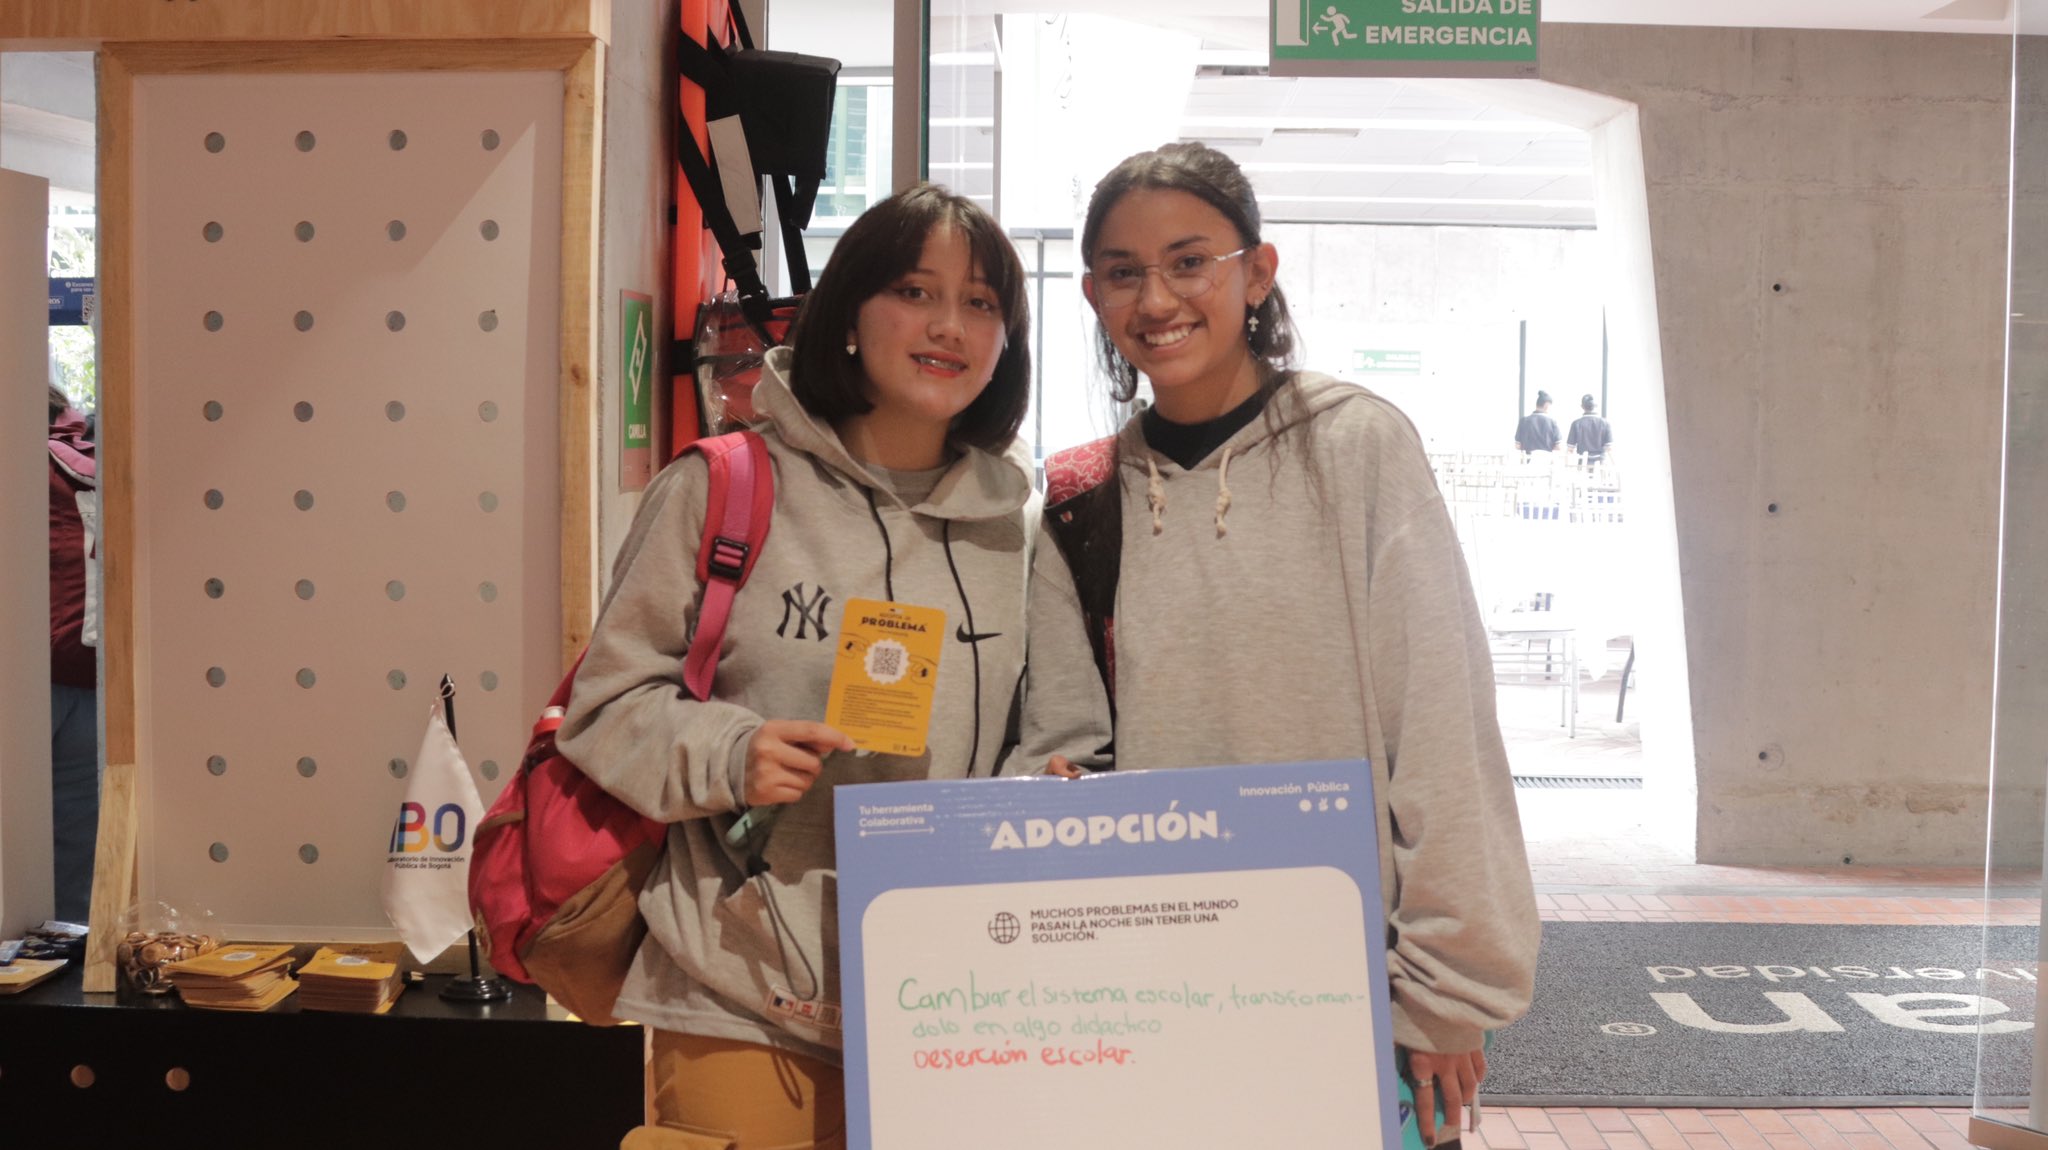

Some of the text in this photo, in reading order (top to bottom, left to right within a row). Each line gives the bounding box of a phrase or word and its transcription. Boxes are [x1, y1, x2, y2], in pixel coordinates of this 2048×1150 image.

[1401, 0, 1532, 14] SALIDA DE
[1365, 25, 1532, 46] EMERGENCIA
[861, 616, 927, 632] PROBLEMA
[1240, 781, 1350, 797] Innovación Pública
[859, 803, 934, 815] Tu herramienta
[859, 815, 925, 827] Colaborativa
[990, 800, 1218, 850] ADOPCIÓN
[428, 862, 451, 870] Bogotá
[429, 855, 465, 863] Innovación
[1030, 899, 1239, 919] MUCHOS PROBLEMAS EN EL MUNDO
[1031, 913, 1219, 931] PASAN LA NOCHE SIN TENER UNA
[1032, 928, 1099, 943] SOLUCIÓN.
[898, 970, 1011, 1013] Cambiar
[1015, 979, 1036, 1007] el
[1042, 986, 1128, 1004] sistema
[912, 1018, 960, 1038] dolo
[974, 1021, 1008, 1036] en
[1013, 1016, 1062, 1041] algo
